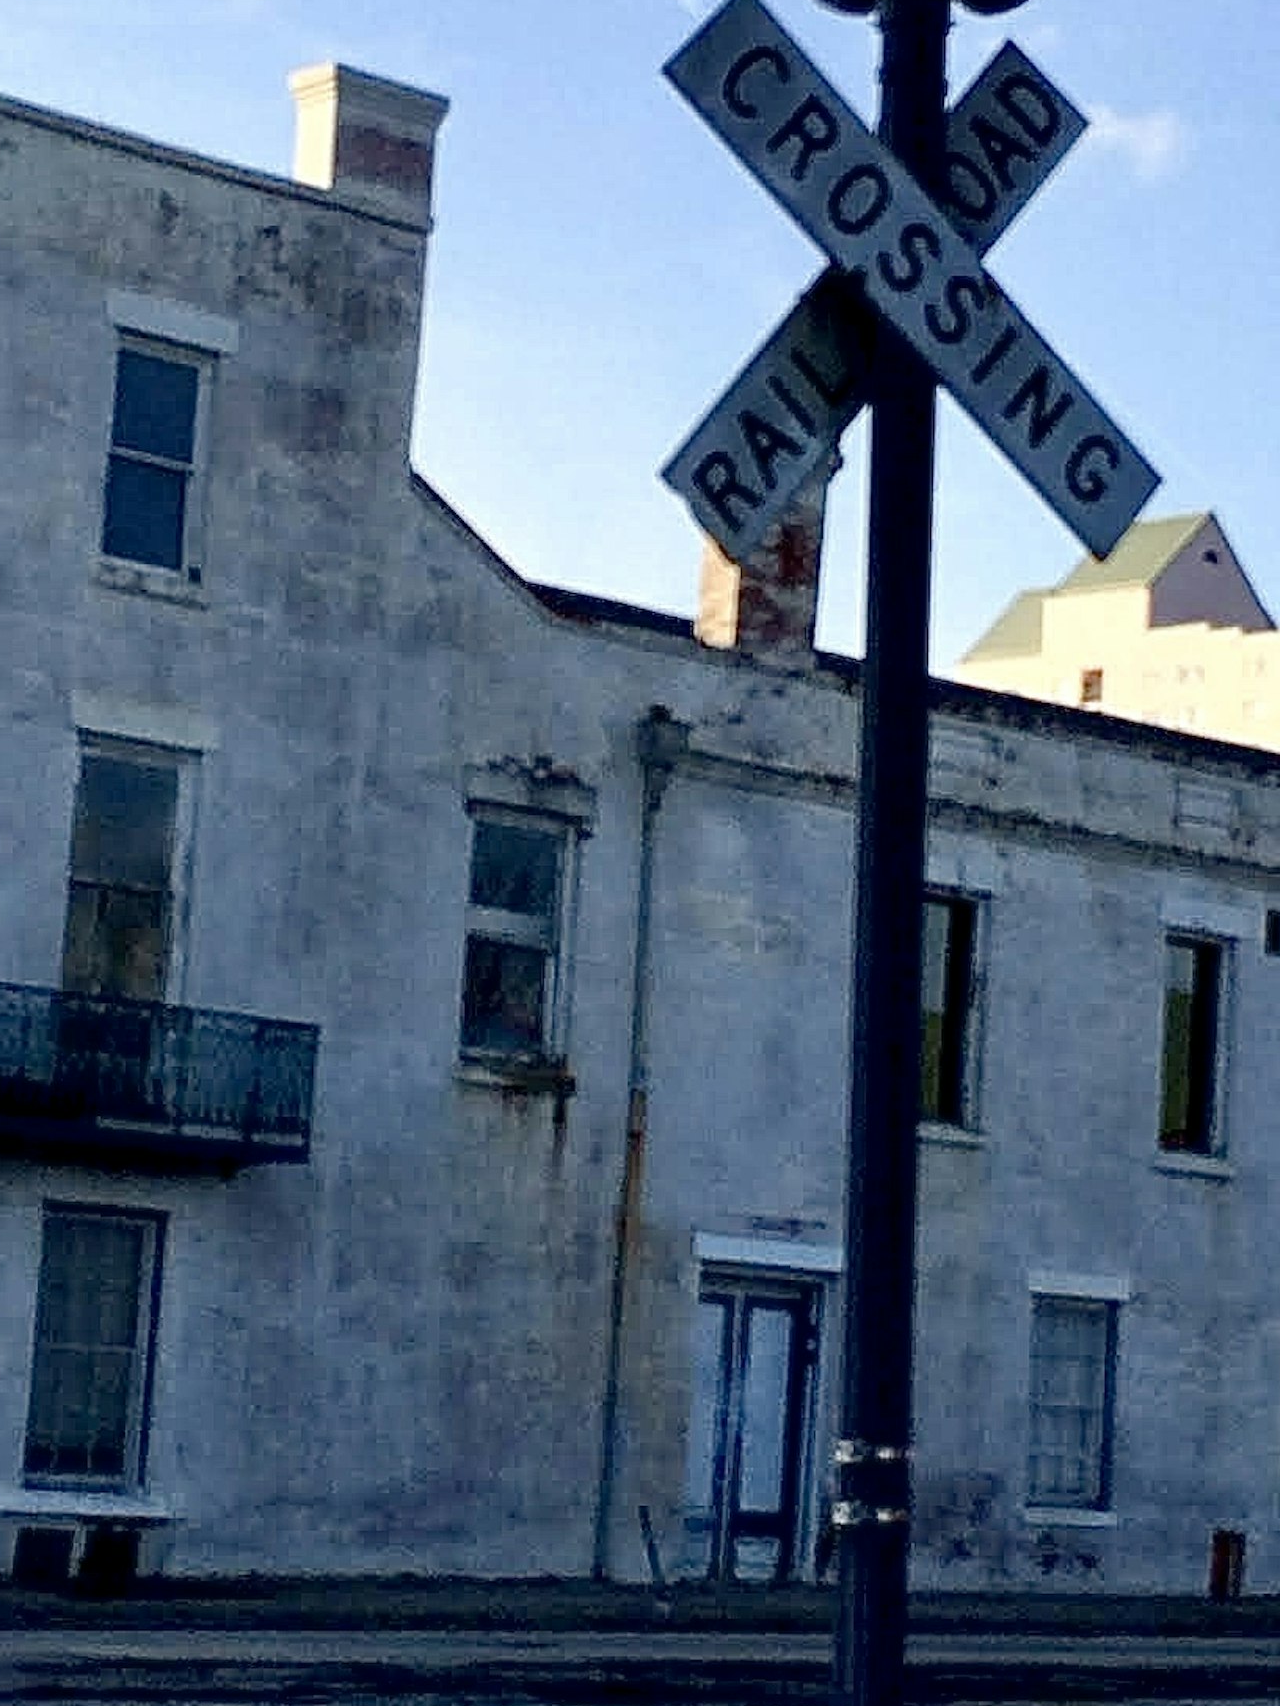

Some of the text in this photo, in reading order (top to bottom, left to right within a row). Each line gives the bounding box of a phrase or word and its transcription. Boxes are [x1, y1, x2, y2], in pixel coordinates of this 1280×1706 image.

[691, 72, 1063, 532] RAIL OAD
[721, 44, 1120, 503] CROSSING
